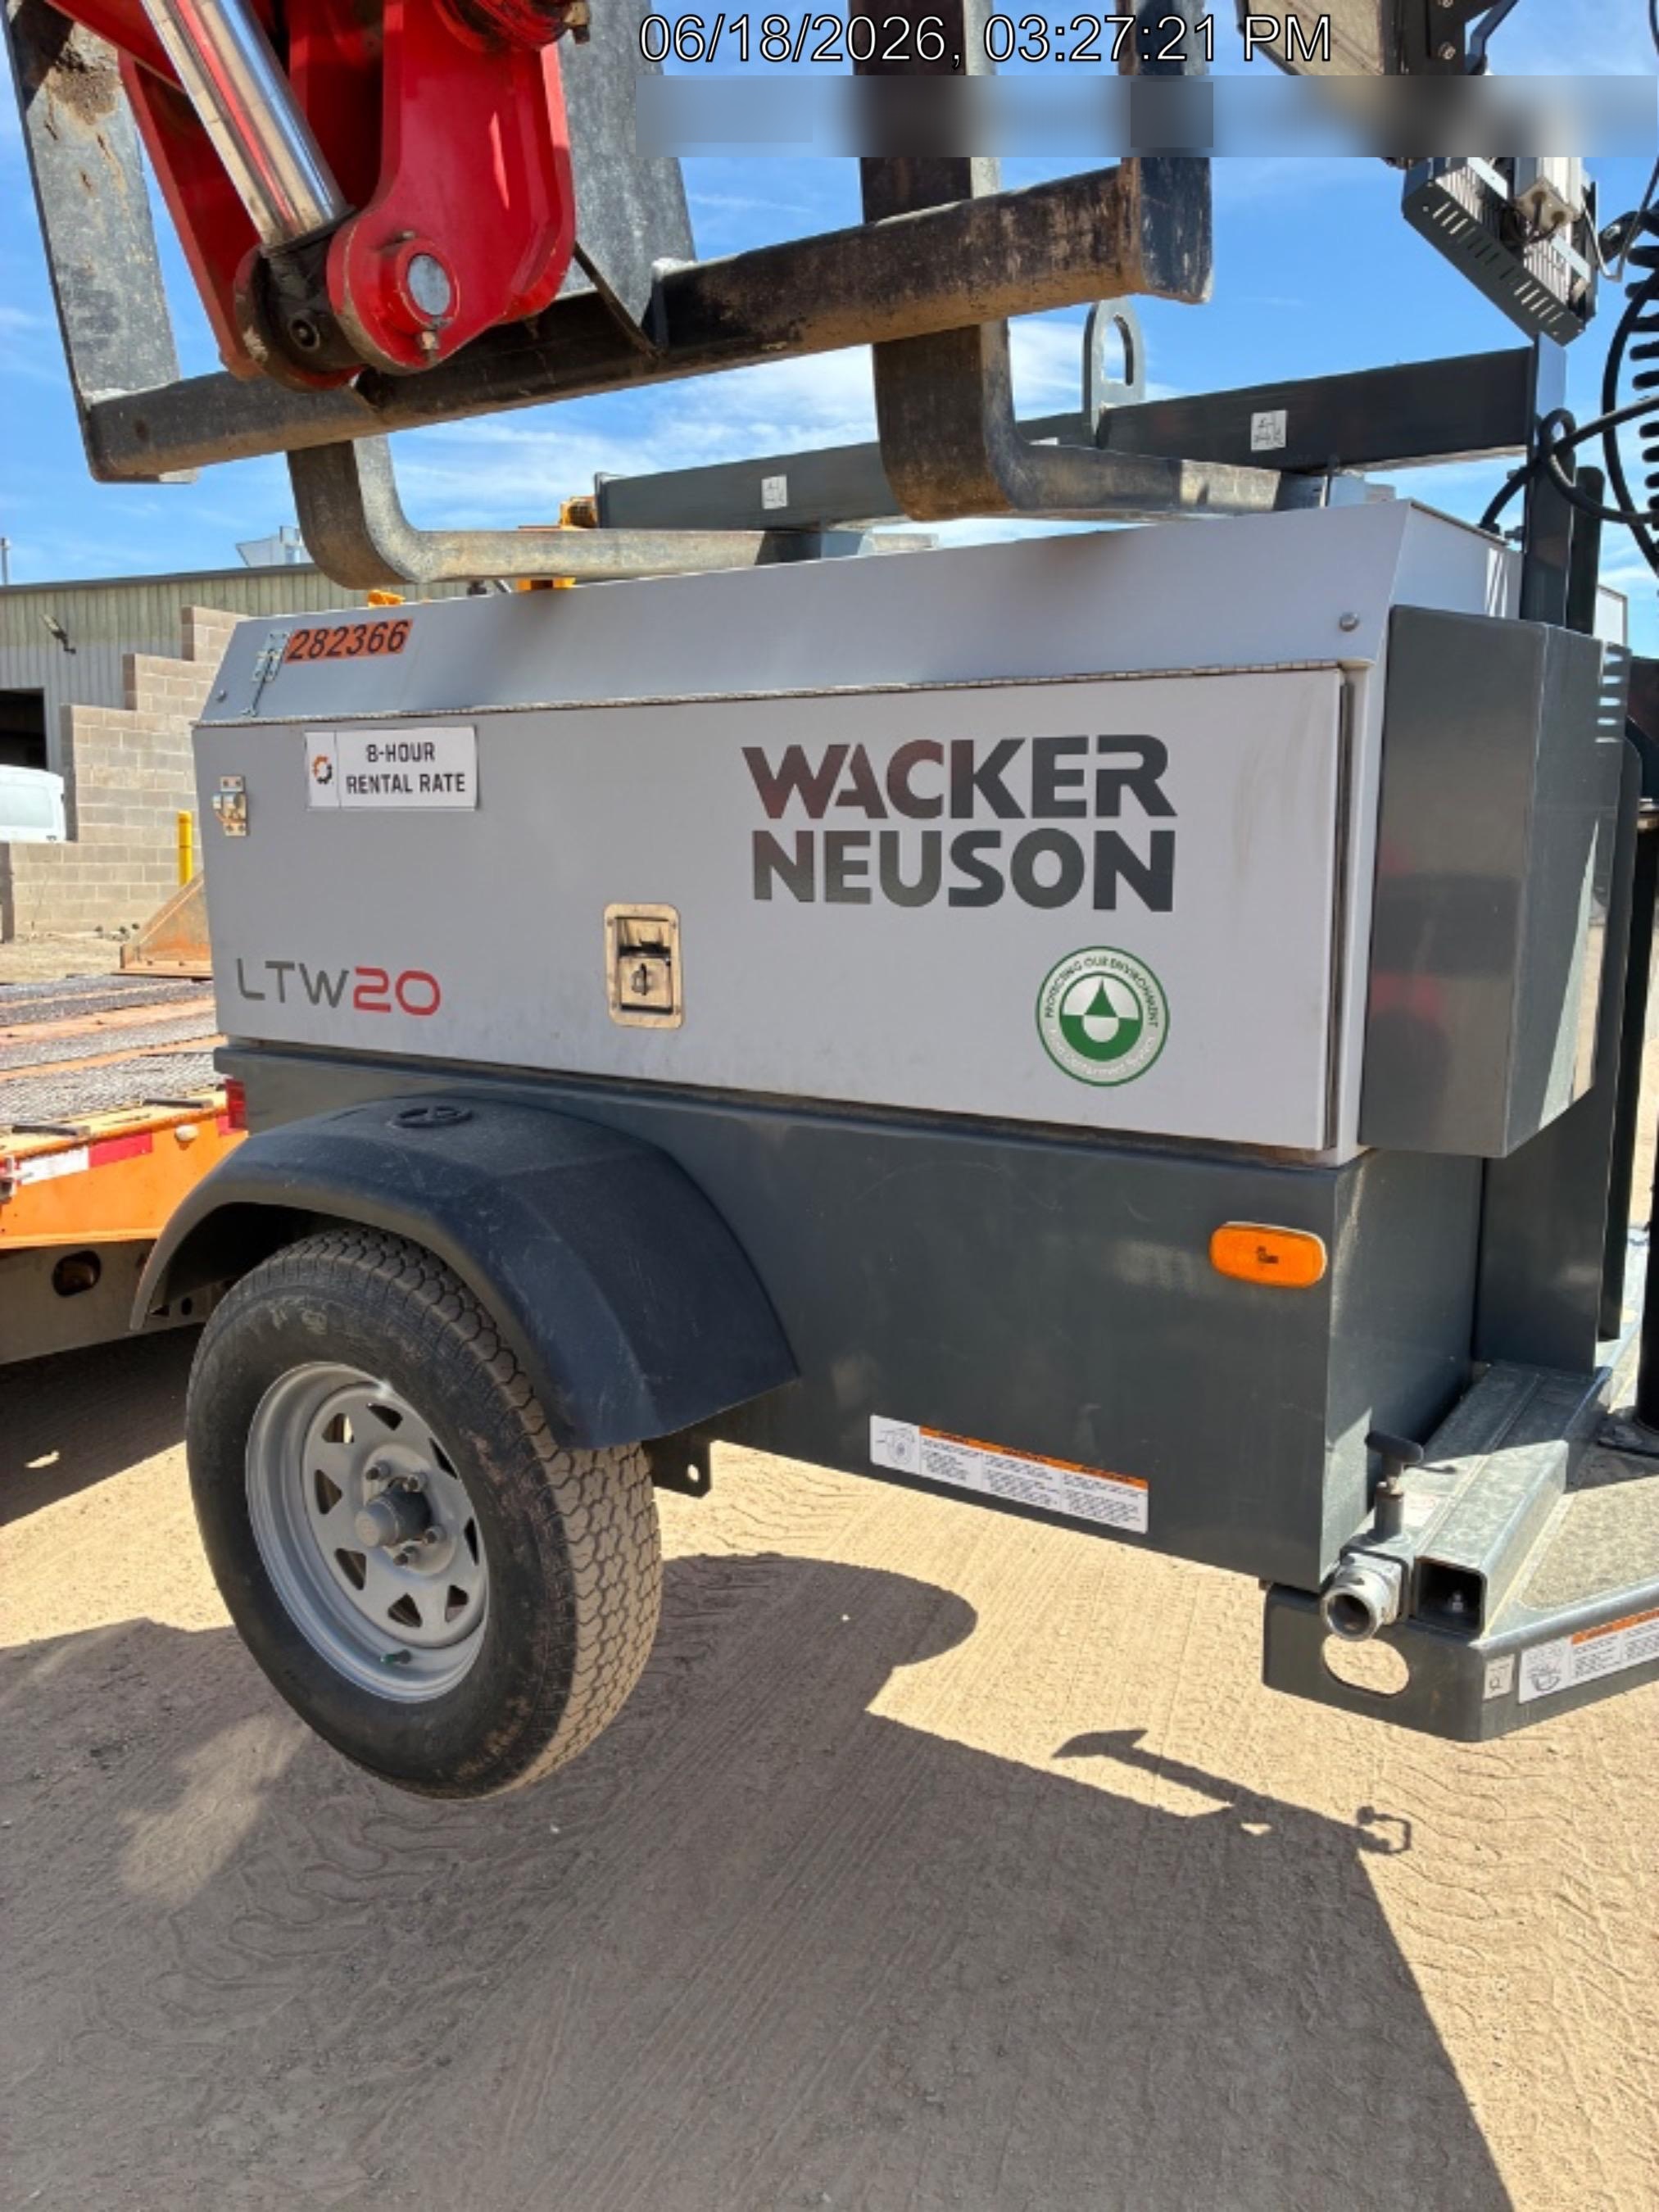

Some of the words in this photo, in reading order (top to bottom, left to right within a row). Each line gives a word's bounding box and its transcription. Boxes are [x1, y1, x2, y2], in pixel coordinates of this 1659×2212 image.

[288, 620, 409, 660] 282366
[366, 742, 436, 763] 8-HOUR
[741, 734, 1178, 819] WACKER
[346, 775, 413, 795] RENTAL
[419, 773, 466, 793] RATE
[751, 827, 1176, 912] NEUSON
[236, 958, 442, 1016] LTW20
